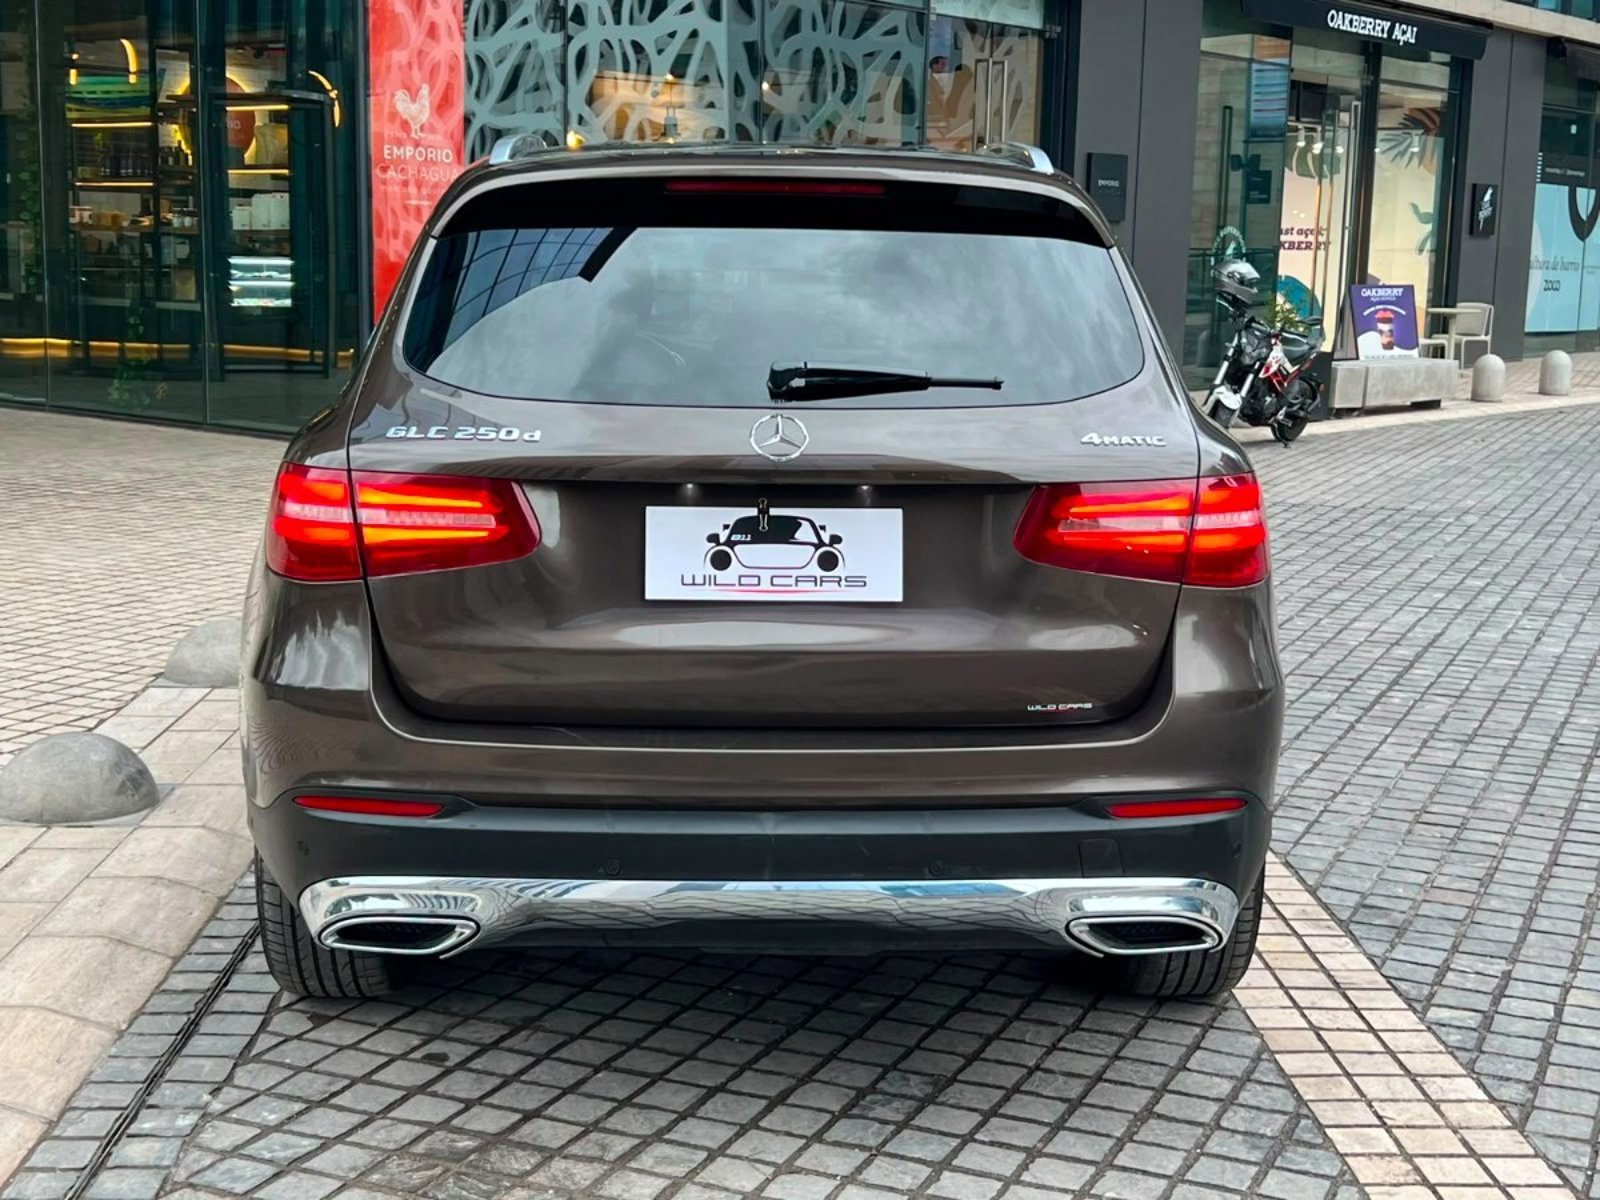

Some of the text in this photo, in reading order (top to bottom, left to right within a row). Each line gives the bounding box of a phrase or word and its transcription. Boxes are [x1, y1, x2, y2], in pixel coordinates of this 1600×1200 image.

[1327, 9, 1391, 39] OAKBERRY
[383, 144, 453, 163] EMPORIO
[376, 163, 460, 182] CACHAGUA
[385, 425, 449, 440] GLC
[1080, 432, 1167, 447] 4MATIC
[681, 574, 868, 588] WILD CARS
